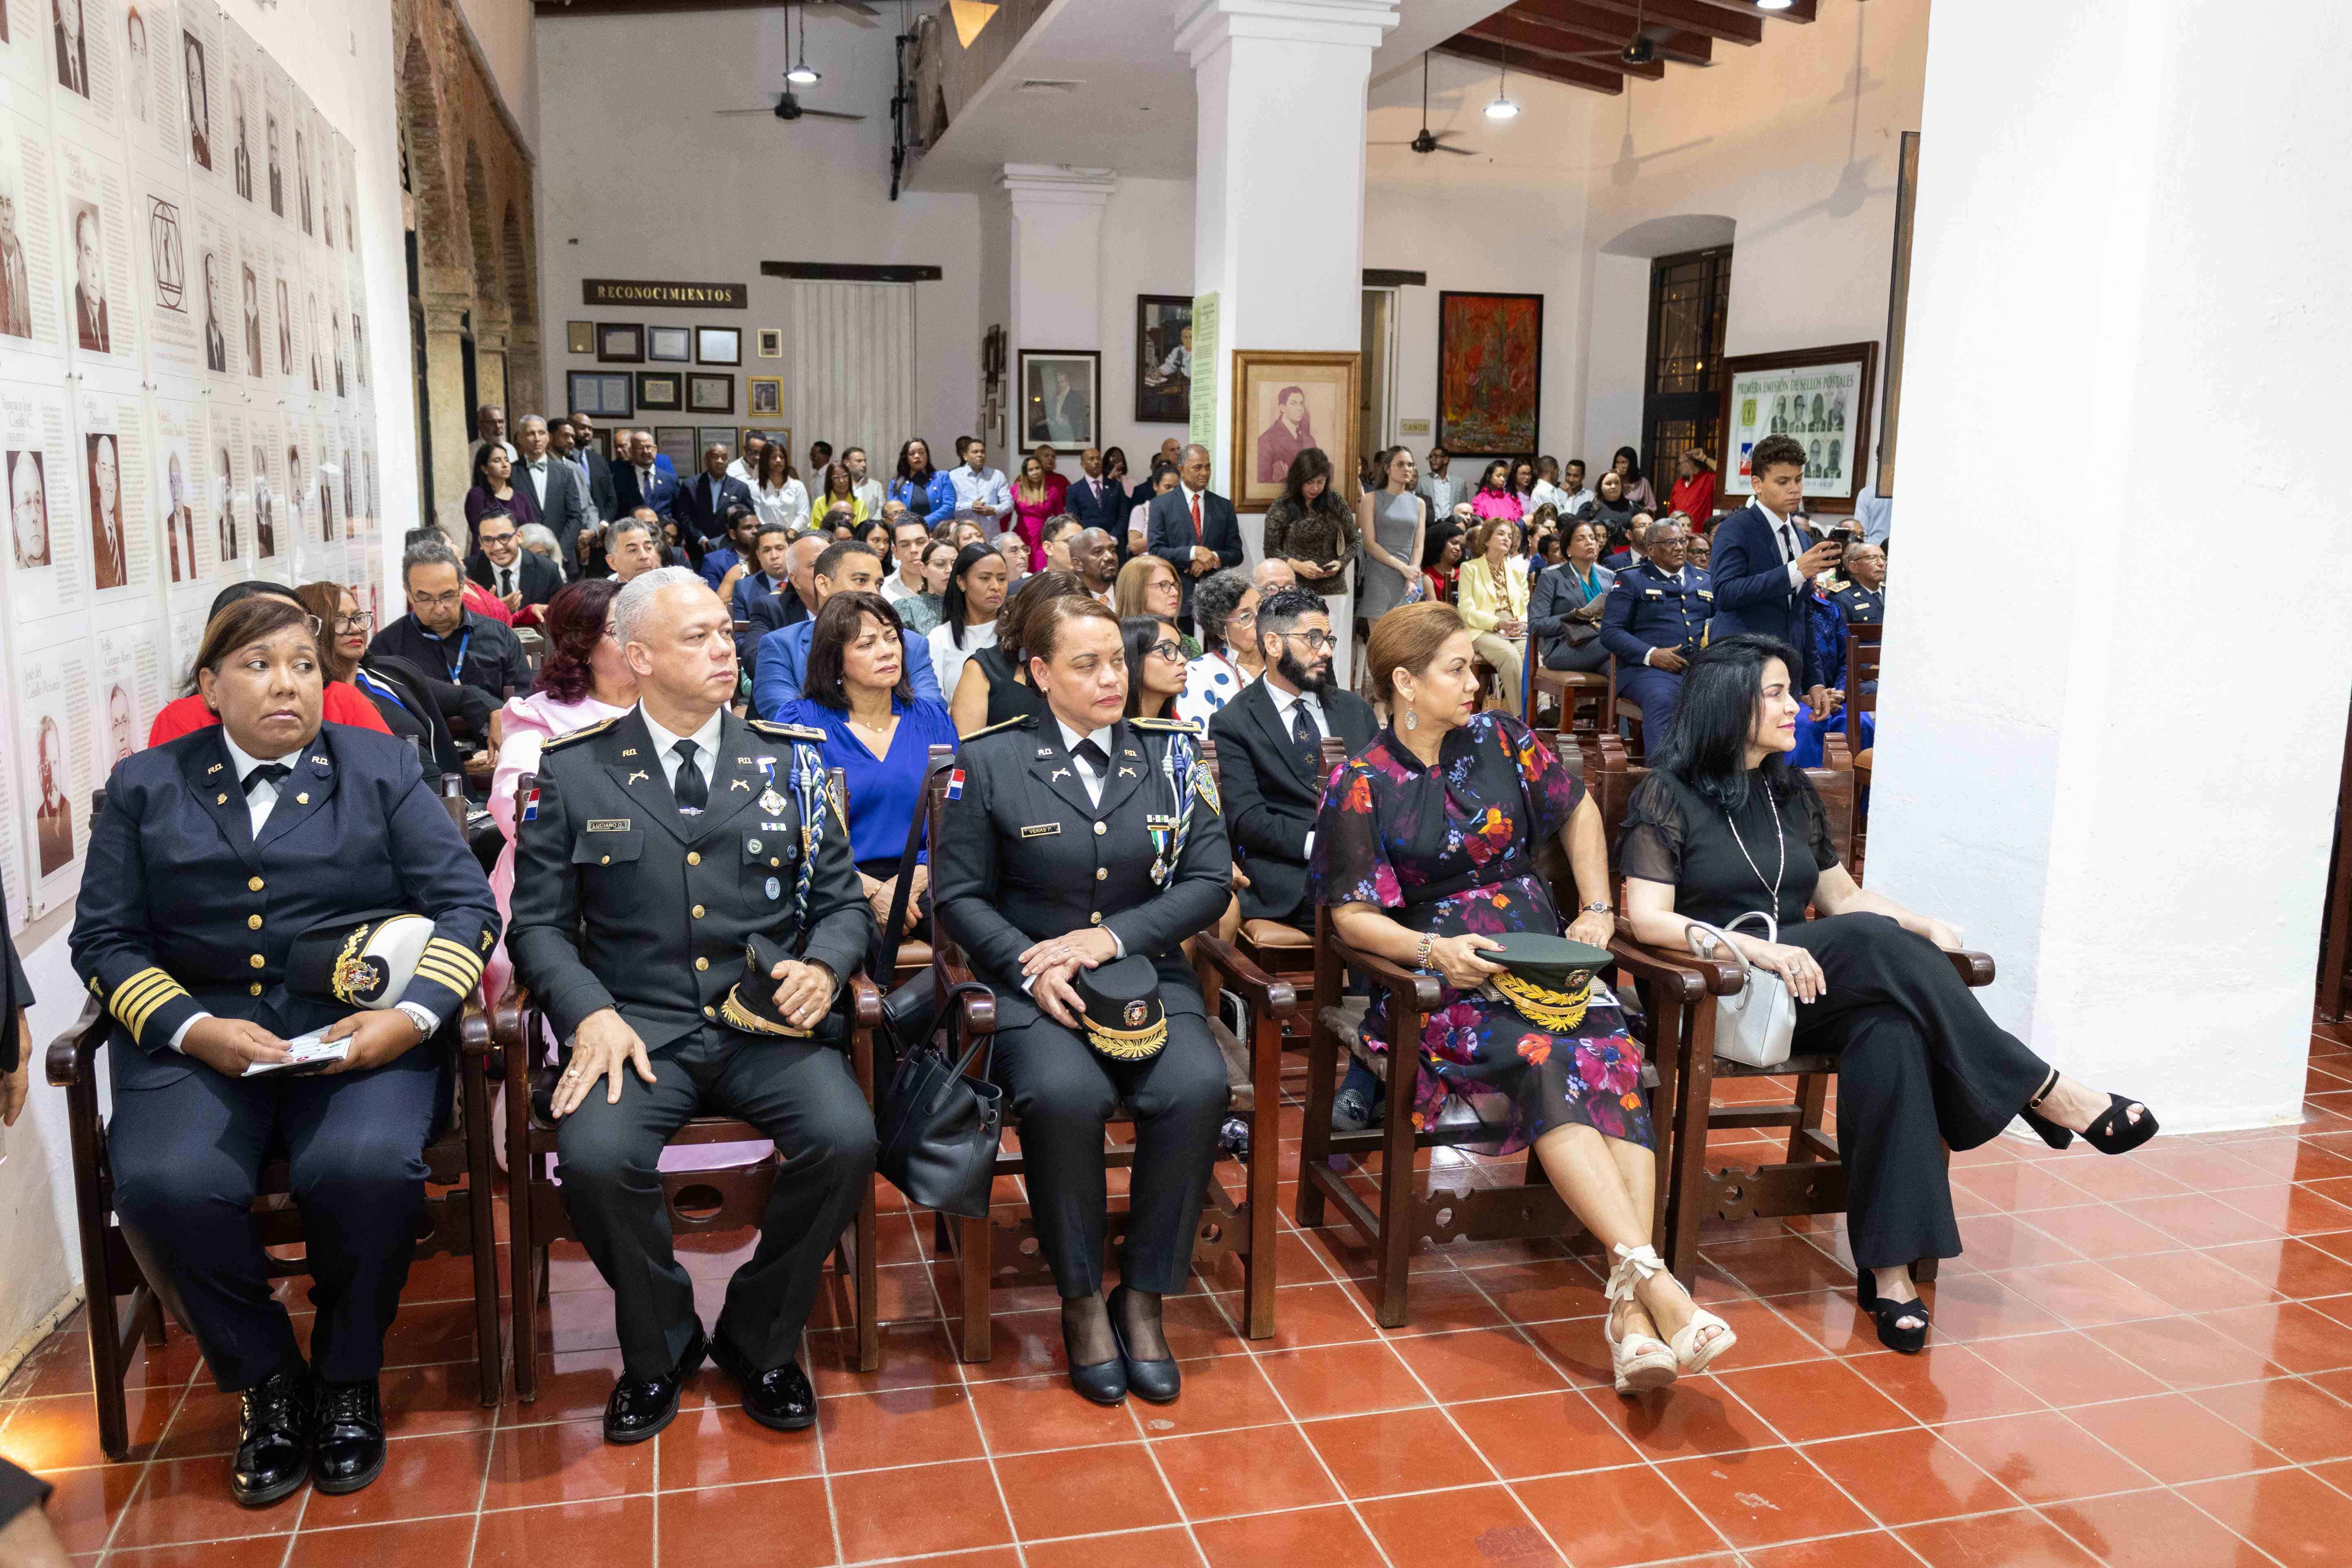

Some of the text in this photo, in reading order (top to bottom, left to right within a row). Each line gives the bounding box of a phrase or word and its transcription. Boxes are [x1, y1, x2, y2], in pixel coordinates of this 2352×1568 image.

[597, 286, 732, 301] RECONOCIMIENTOS
[1737, 381, 1761, 395] PRIMERA
[1791, 378, 1798, 391] DE
[1800, 377, 1821, 391] SELLOS
[1823, 374, 1854, 389] POSTALES
[1402, 421, 1428, 431] BAÑOS
[622, 748, 637, 757] R.D.
[311, 756, 328, 765] R.D.
[208, 763, 223, 774] R.D.
